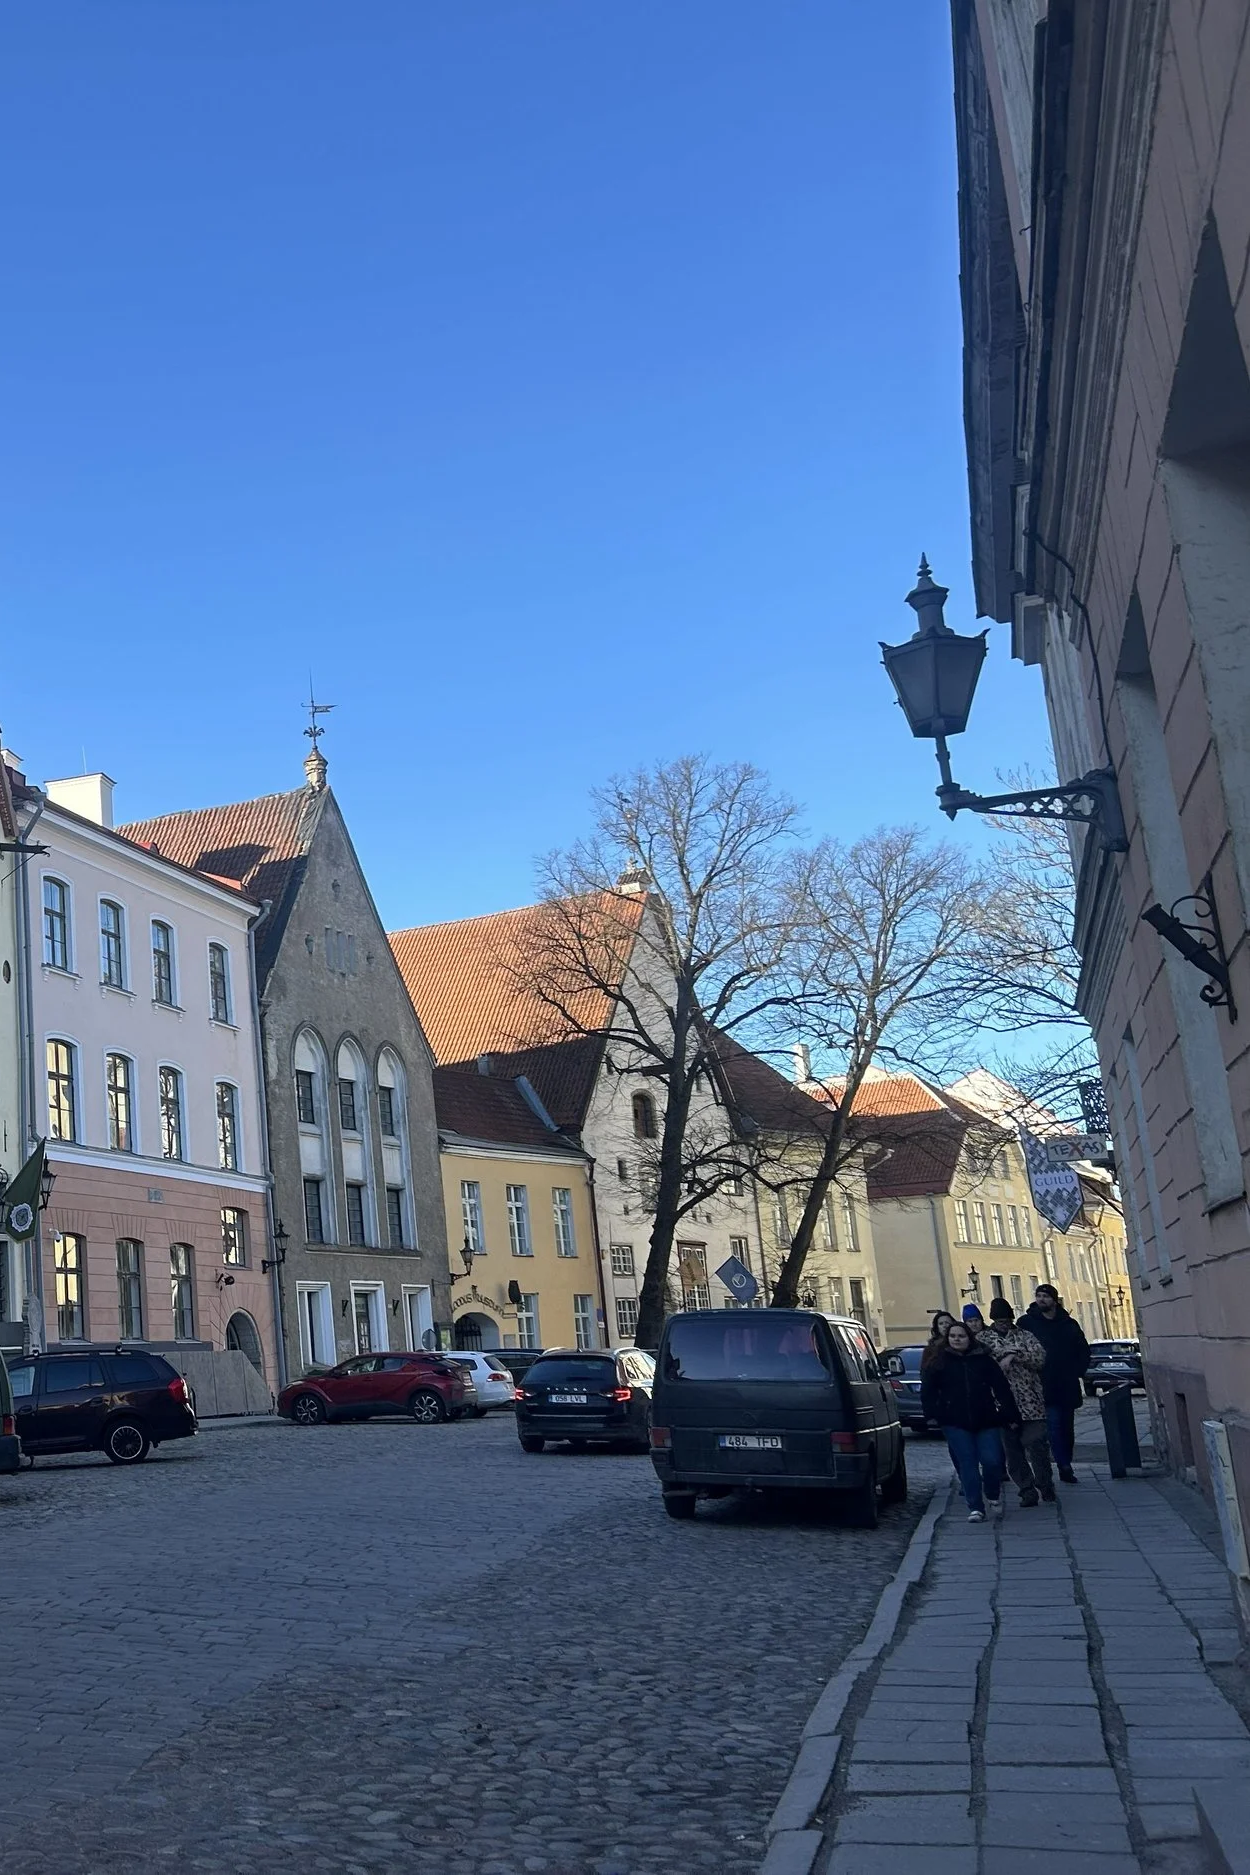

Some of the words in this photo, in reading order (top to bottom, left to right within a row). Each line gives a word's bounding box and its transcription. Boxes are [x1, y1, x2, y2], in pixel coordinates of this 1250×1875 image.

[1050, 1141, 1100, 1158] TEXAS
[1035, 1175, 1074, 1186] GUILD
[728, 1436, 748, 1447] 484
